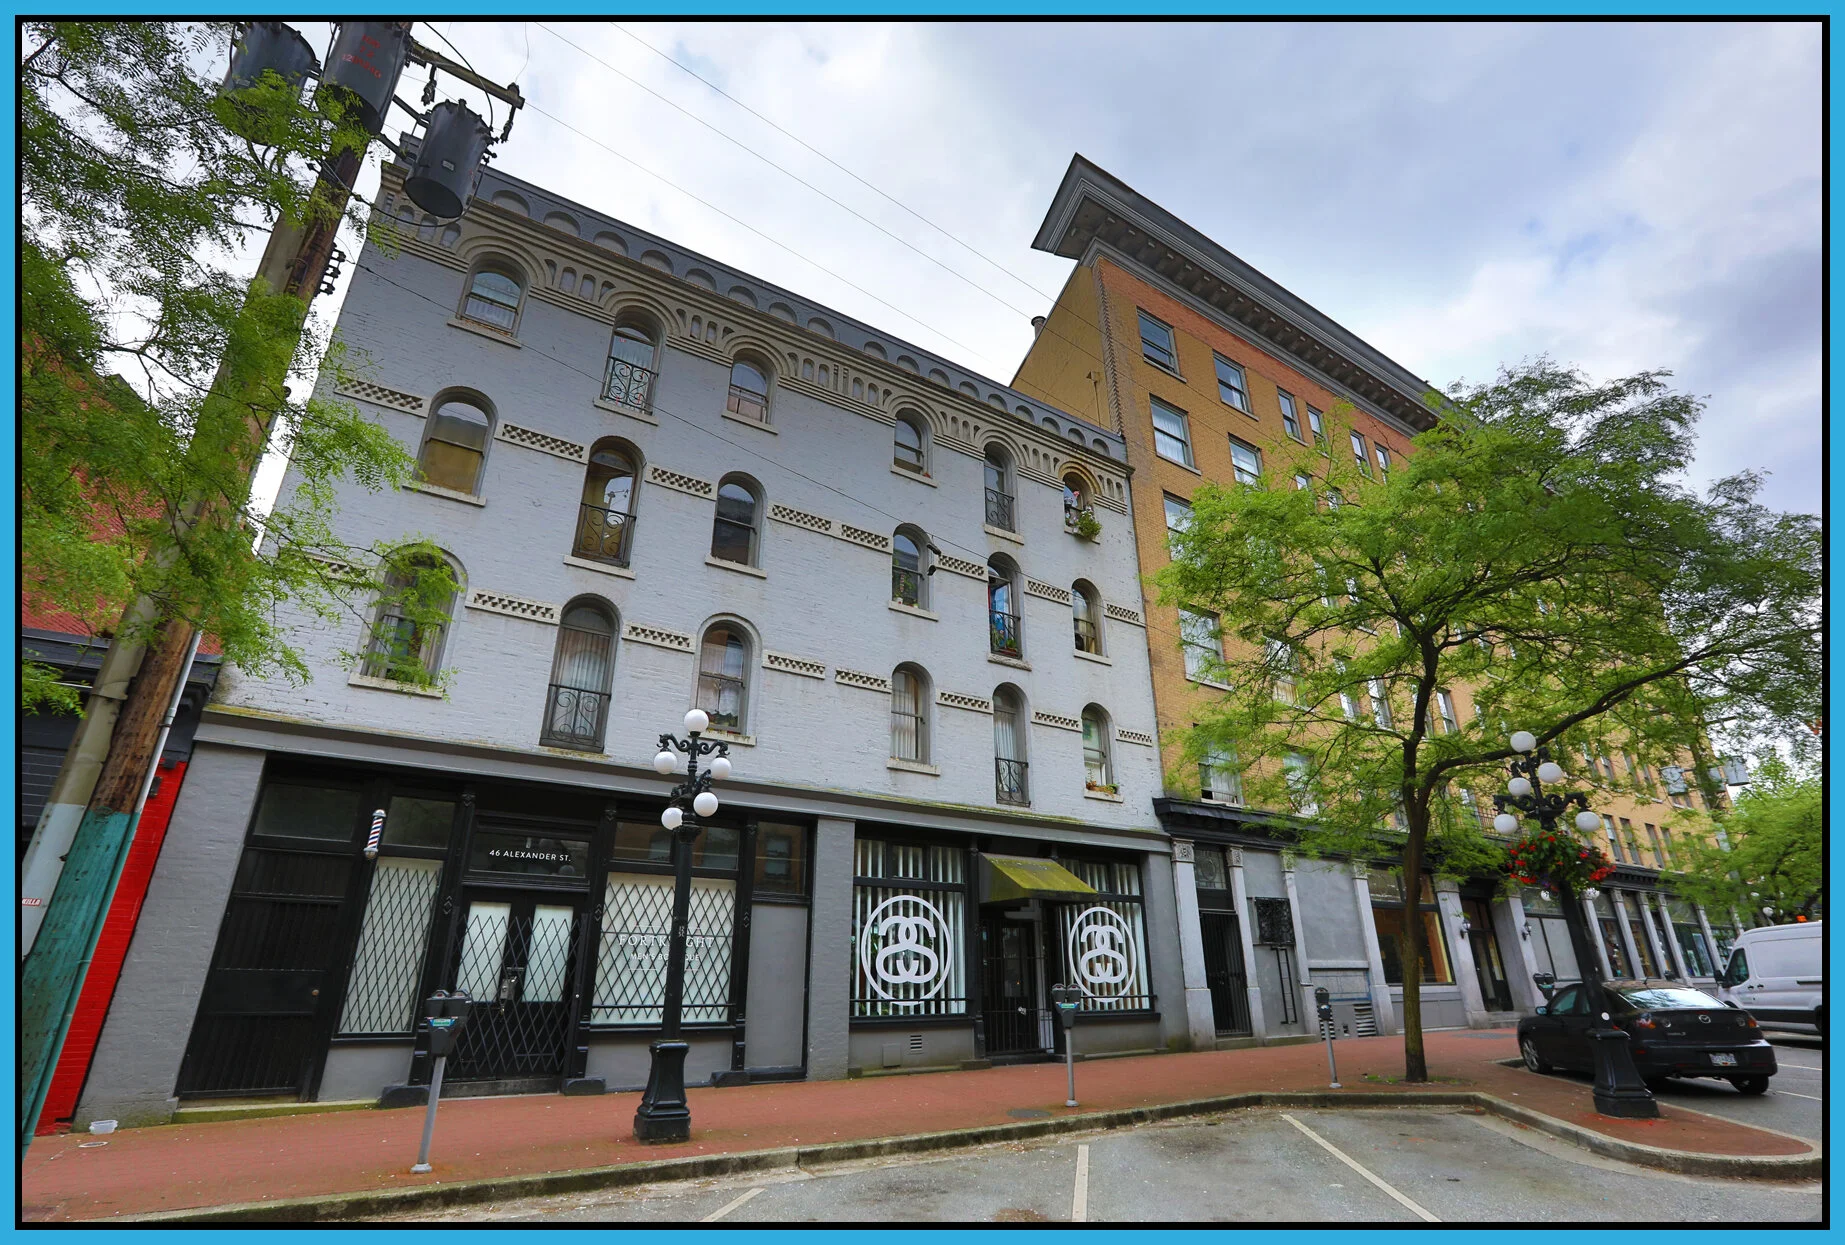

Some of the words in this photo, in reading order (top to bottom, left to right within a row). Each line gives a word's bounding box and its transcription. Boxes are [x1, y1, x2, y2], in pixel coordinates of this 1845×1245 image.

[503, 850, 556, 860] ALEXANDER
[559, 854, 571, 862] ST.
[619, 935, 714, 948] FORTKGHT
[659, 953, 699, 961] BOQUE
